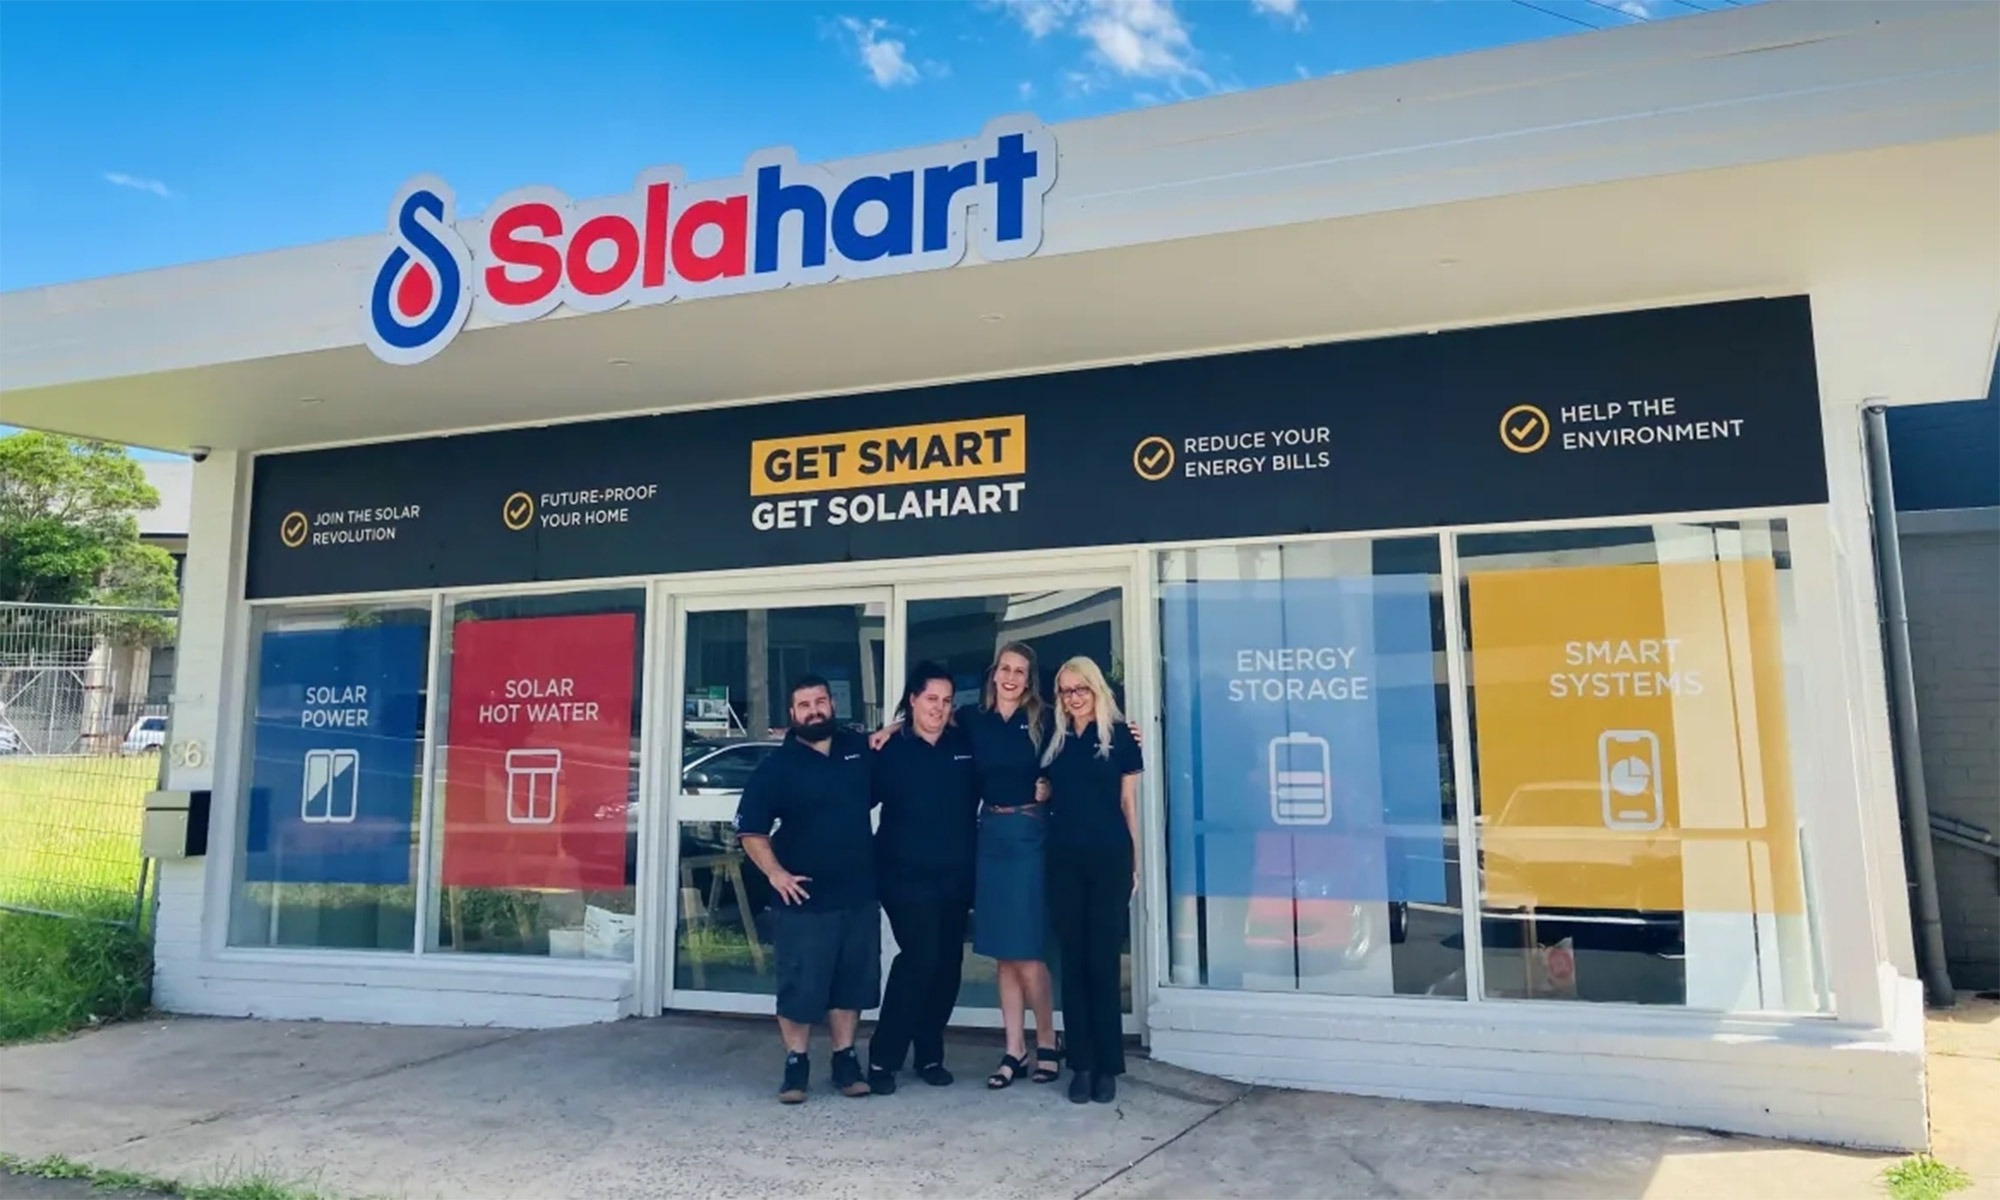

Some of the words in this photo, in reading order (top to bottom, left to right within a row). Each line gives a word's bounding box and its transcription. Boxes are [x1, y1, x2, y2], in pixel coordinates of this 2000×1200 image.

[484, 132, 1038, 306] Solahart
[1560, 402, 1622, 424] HELP
[1628, 397, 1677, 418] THE
[1184, 431, 1266, 453] REDUCE
[1271, 426, 1331, 447] YOUR
[1562, 418, 1745, 450] ENVIRONMENT
[764, 443, 846, 483] GET
[858, 427, 1012, 475] SMART
[1184, 455, 1267, 478] ENERGY
[1272, 451, 1331, 472] BILLS
[540, 484, 658, 508] FUTURE-PROOF
[752, 498, 819, 531] GET
[827, 482, 1026, 525] SOLAHART
[312, 511, 344, 527] JOIN
[347, 508, 372, 524] THE
[375, 504, 421, 521] SOLAR
[539, 511, 581, 528] YOUR
[585, 508, 629, 525] HOME
[312, 527, 397, 546] REVOLUTION
[1236, 646, 1357, 673] ENERGY
[1565, 637, 1683, 666] SMART
[305, 684, 368, 705] SOLAR
[504, 677, 574, 699] SOLAR
[1228, 676, 1369, 702] STORAGE
[1549, 670, 1704, 698] SYSTEMS
[301, 708, 369, 729] POWER
[478, 703, 521, 724] HOT
[526, 701, 600, 723] WATER
